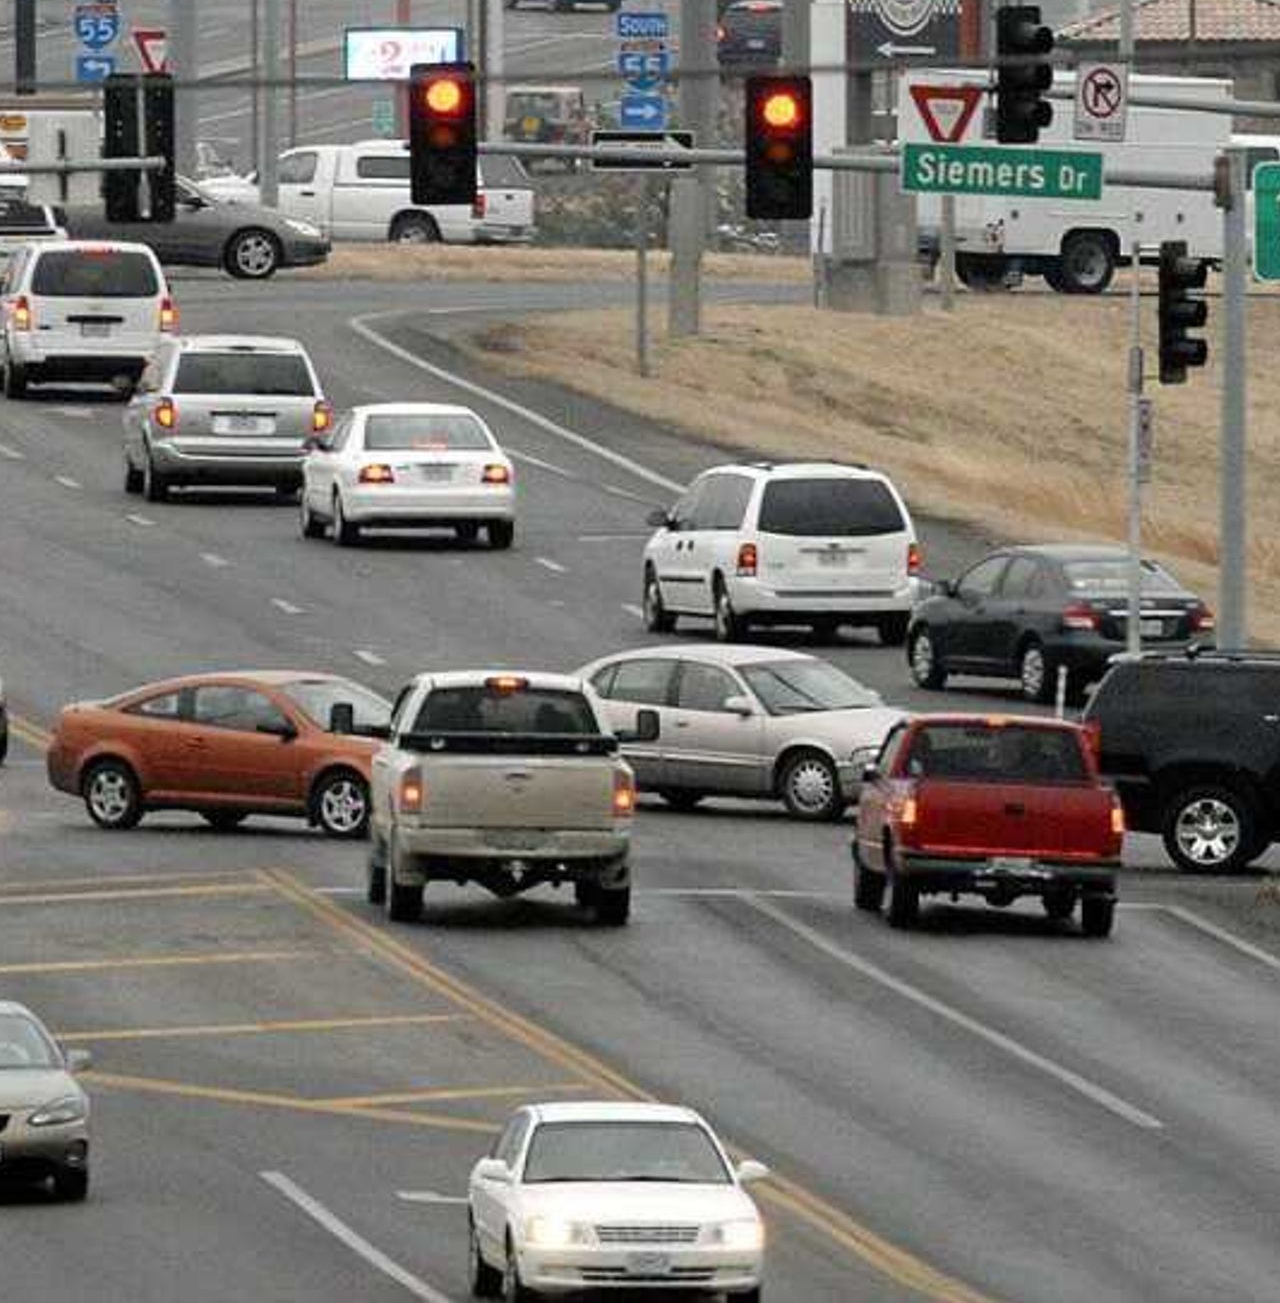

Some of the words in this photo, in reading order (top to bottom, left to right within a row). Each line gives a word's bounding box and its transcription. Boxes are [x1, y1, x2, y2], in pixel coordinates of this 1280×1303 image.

[79, 18, 114, 42] 55
[917, 153, 1046, 190] Siemers
[1058, 164, 1087, 193] Dr
